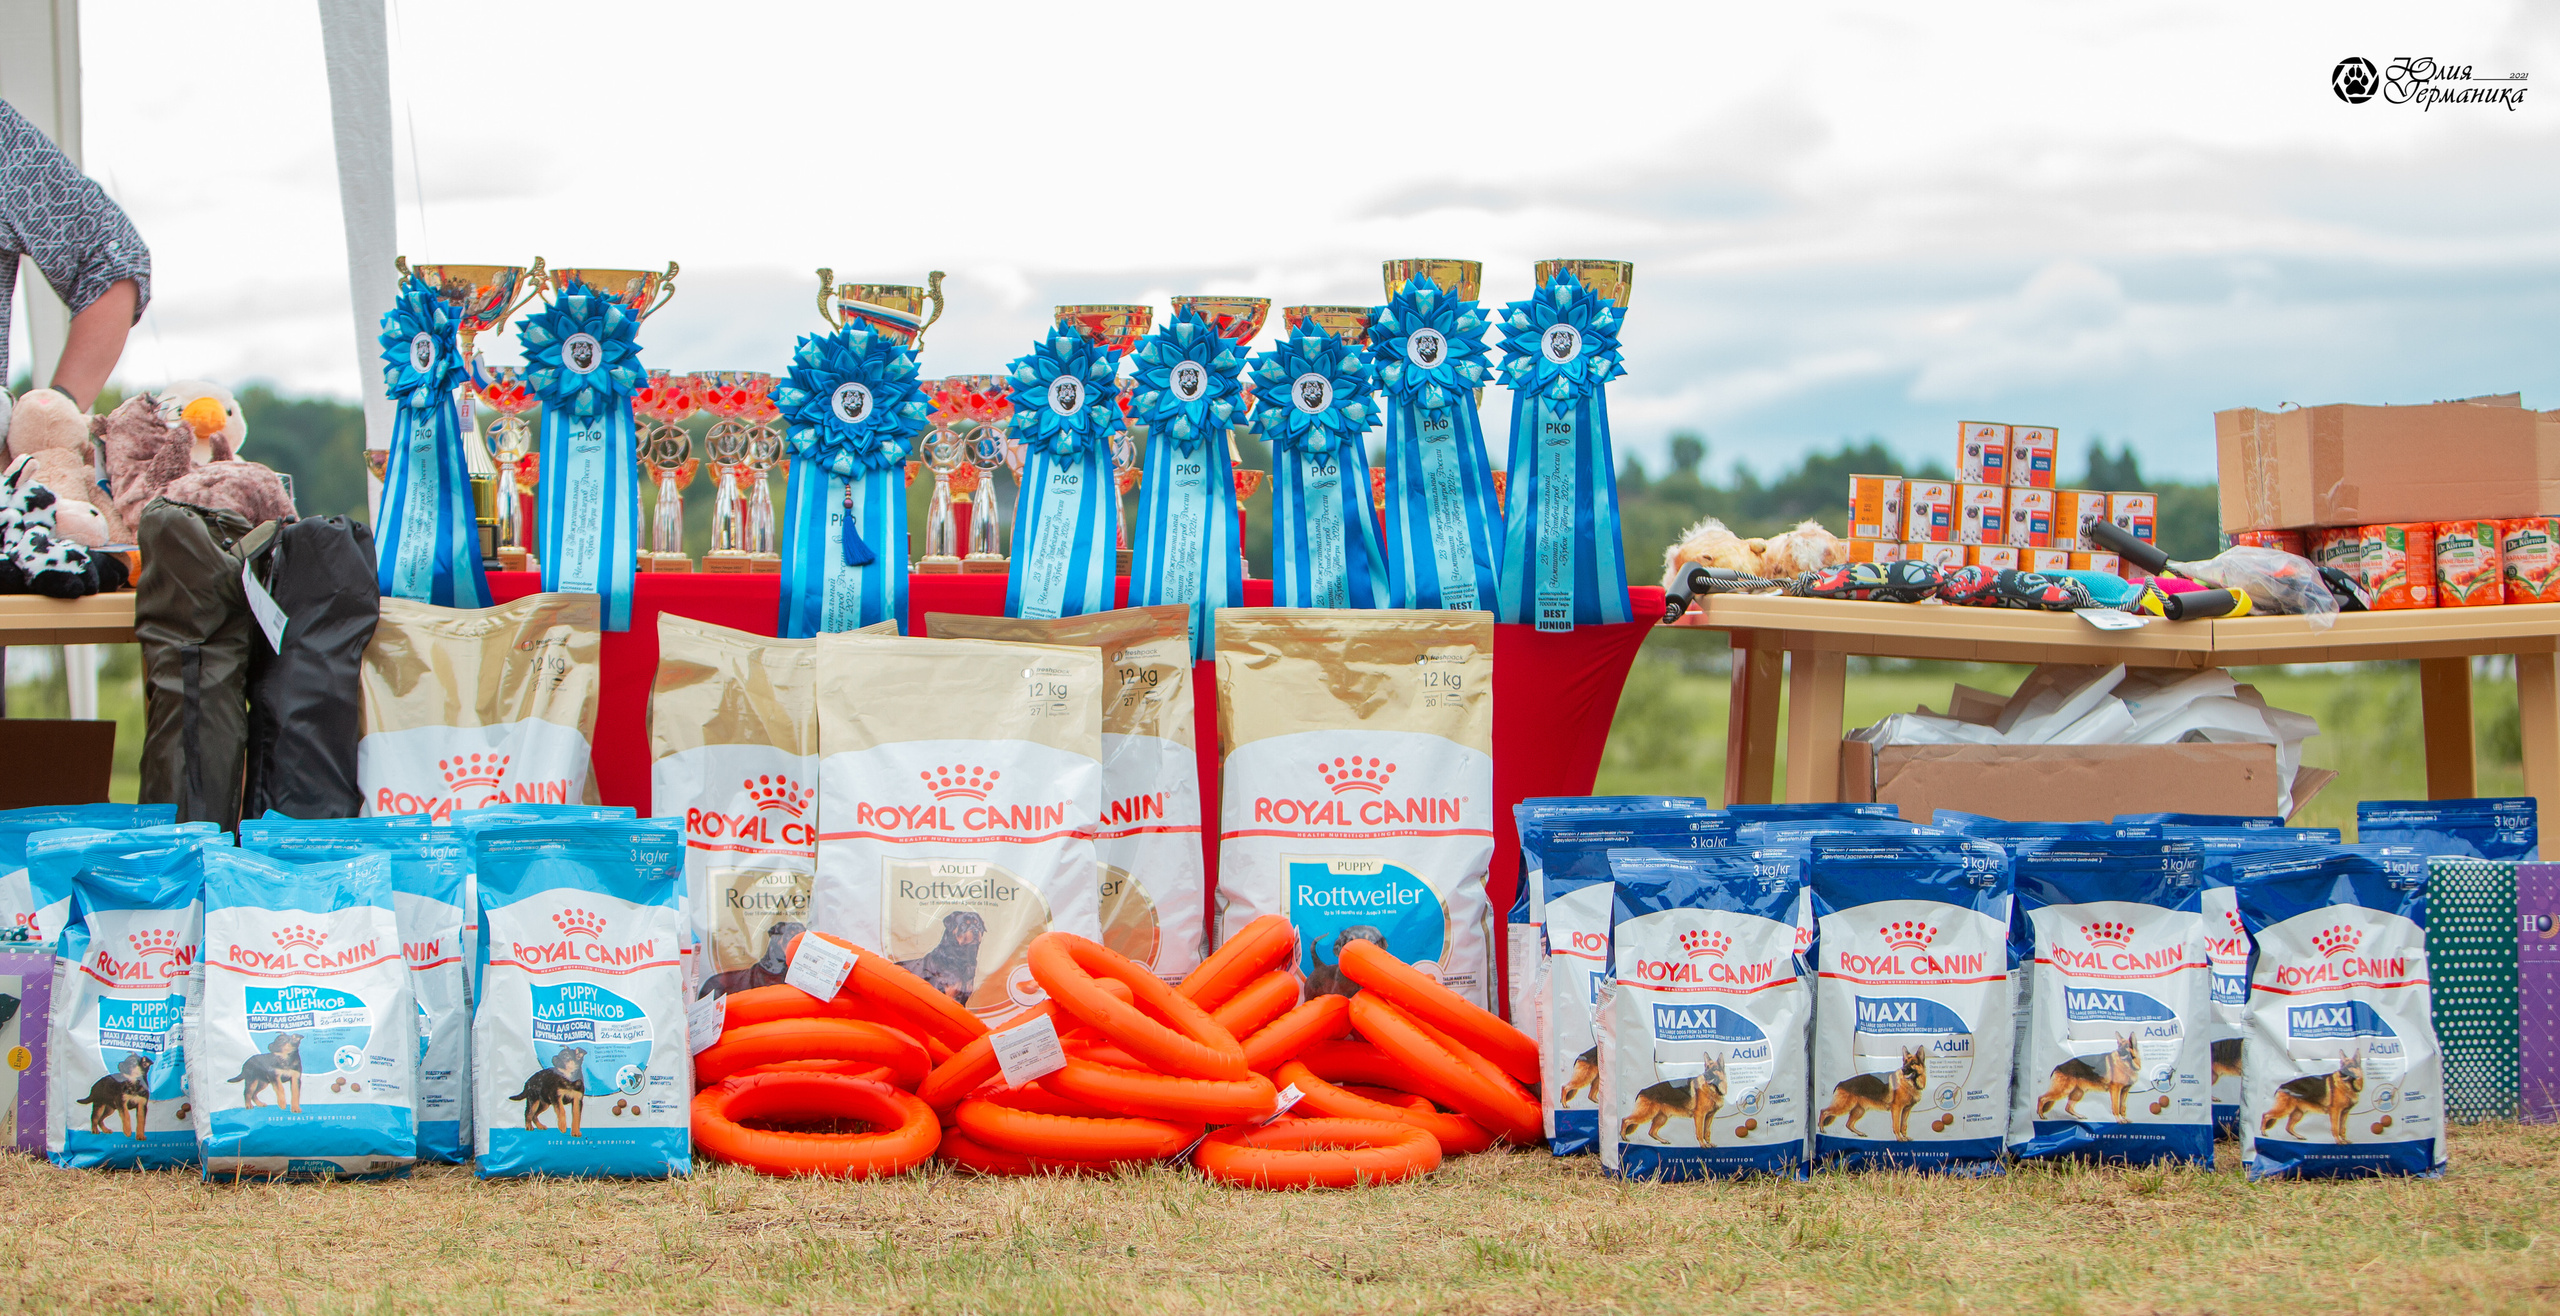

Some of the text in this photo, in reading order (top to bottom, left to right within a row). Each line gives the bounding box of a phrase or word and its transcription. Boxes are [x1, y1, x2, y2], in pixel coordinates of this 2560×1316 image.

[1424, 420, 1449, 432] РКФ
[1546, 423, 1571, 434] РКФ
[414, 430, 432, 440] РКФ
[577, 431, 602, 441] РКФ
[1176, 464, 1200, 475] РКФ
[1312, 466, 1336, 477] РКФ
[1053, 475, 1078, 485] РКФ
[1541, 554, 1549, 565] 23
[1166, 587, 1173, 599] 23
[1450, 601, 1473, 610] BEST
[1544, 610, 1566, 618] BEST
[1539, 621, 1571, 629] JUNIOR
[531, 655, 565, 674] 12 kg
[1119, 668, 1157, 686] 12 kg
[1423, 670, 1462, 690] 12 kg
[1029, 682, 1067, 699] 12 kg
[1124, 698, 1133, 706] 27
[1426, 699, 1436, 707] 20
[857, 801, 1064, 831] ROYAL CANIN
[1255, 797, 1459, 825] ROYAL CANIN
[687, 807, 774, 843] ROYAL
[2494, 815, 2529, 828] 3 kg/кг
[1691, 837, 1697, 848] 3
[421, 846, 458, 859] 3 kg/кг
[630, 849, 668, 865] 3 kg/кг
[939, 865, 977, 874] ADULT
[1338, 862, 1373, 871] PUPPY
[1753, 863, 1790, 877] 3 kg/кг
[1962, 857, 1999, 871] 3 kg/кг
[2162, 858, 2196, 872] 3 kg/кг
[2383, 861, 2419, 876] 3 kg/кг
[346, 872, 351, 880] 3
[762, 875, 798, 885] ADULT
[900, 879, 1019, 901] Rottweiler
[1299, 882, 1423, 907] Rottweiler
[230, 940, 377, 970] ROYAL CANIN
[513, 939, 654, 965] ROYAL CANIN
[2052, 942, 2182, 970] ROYAL CANIN
[97, 950, 154, 981] ROYAL
[1841, 952, 1983, 975] ROYAL CANIN
[1637, 960, 1772, 985] ROYAL CANIN
[2277, 957, 2404, 986] ROYAL CANIN
[278, 988, 317, 1000] PUPPY
[561, 986, 598, 1000] PUPPY
[132, 1002, 168, 1015] PUPPY
[252, 997, 345, 1014] ДЛЯ ЩЕНКОВ
[2068, 992, 2124, 1012] MAXI
[538, 1002, 624, 1019] ДЛЯ ЩЕНКОВ
[1859, 1001, 1917, 1022] MAXI
[105, 1015, 134, 1028] ДЛЯ
[275, 1015, 286, 1023] ДЛЯ
[288, 1013, 309, 1021] СОБАК
[320, 1016, 365, 1026] 26-44 kg/кг
[1657, 1009, 1716, 1029] MAXI
[2292, 1007, 2353, 1028] MAXI
[250, 1020, 313, 1030] КРУПНЫХ РАЗМЕРОВ
[556, 1024, 569, 1033] ДЛЯ
[571, 1022, 591, 1030] СОБАК
[2145, 1024, 2178, 1038] Adult
[125, 1033, 139, 1041] ДЛЯ
[140, 1035, 161, 1043] СОБАК
[535, 1032, 593, 1040] КРУПНЫХ РАЗМЕРОВ
[623, 1030, 645, 1039] kg/кг
[101, 1039, 163, 1051] КРУПНЫХ РАЗМЕРОВ
[1933, 1039, 1969, 1052] Adult
[2369, 1043, 2400, 1055] Adult
[14, 1049, 23, 1068] Евро
[1732, 1045, 1767, 1059] Adult
